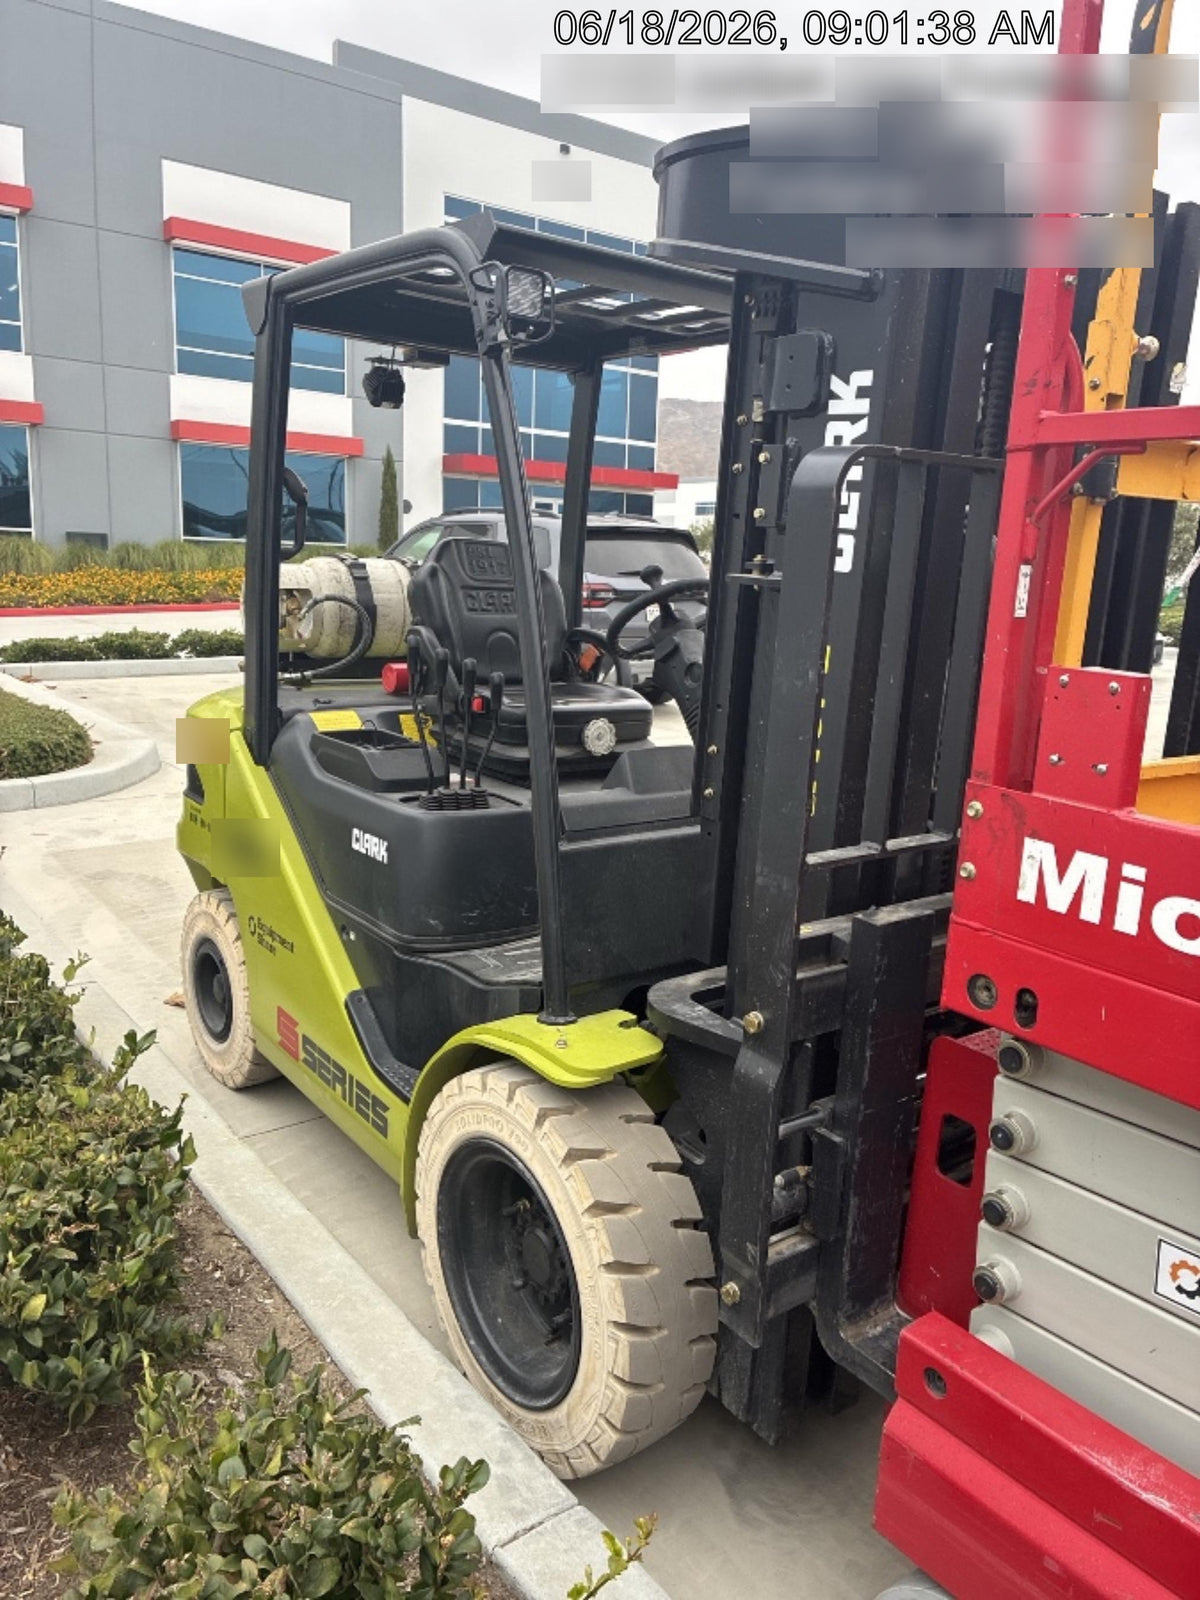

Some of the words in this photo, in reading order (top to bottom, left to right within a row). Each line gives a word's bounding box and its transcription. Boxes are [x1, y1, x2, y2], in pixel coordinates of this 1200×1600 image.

[824, 369, 874, 573] CLRK
[465, 590, 514, 614] CLAR
[351, 827, 389, 865] CLARK
[276, 1005, 299, 1062] S
[301, 1033, 391, 1140] SERIES
